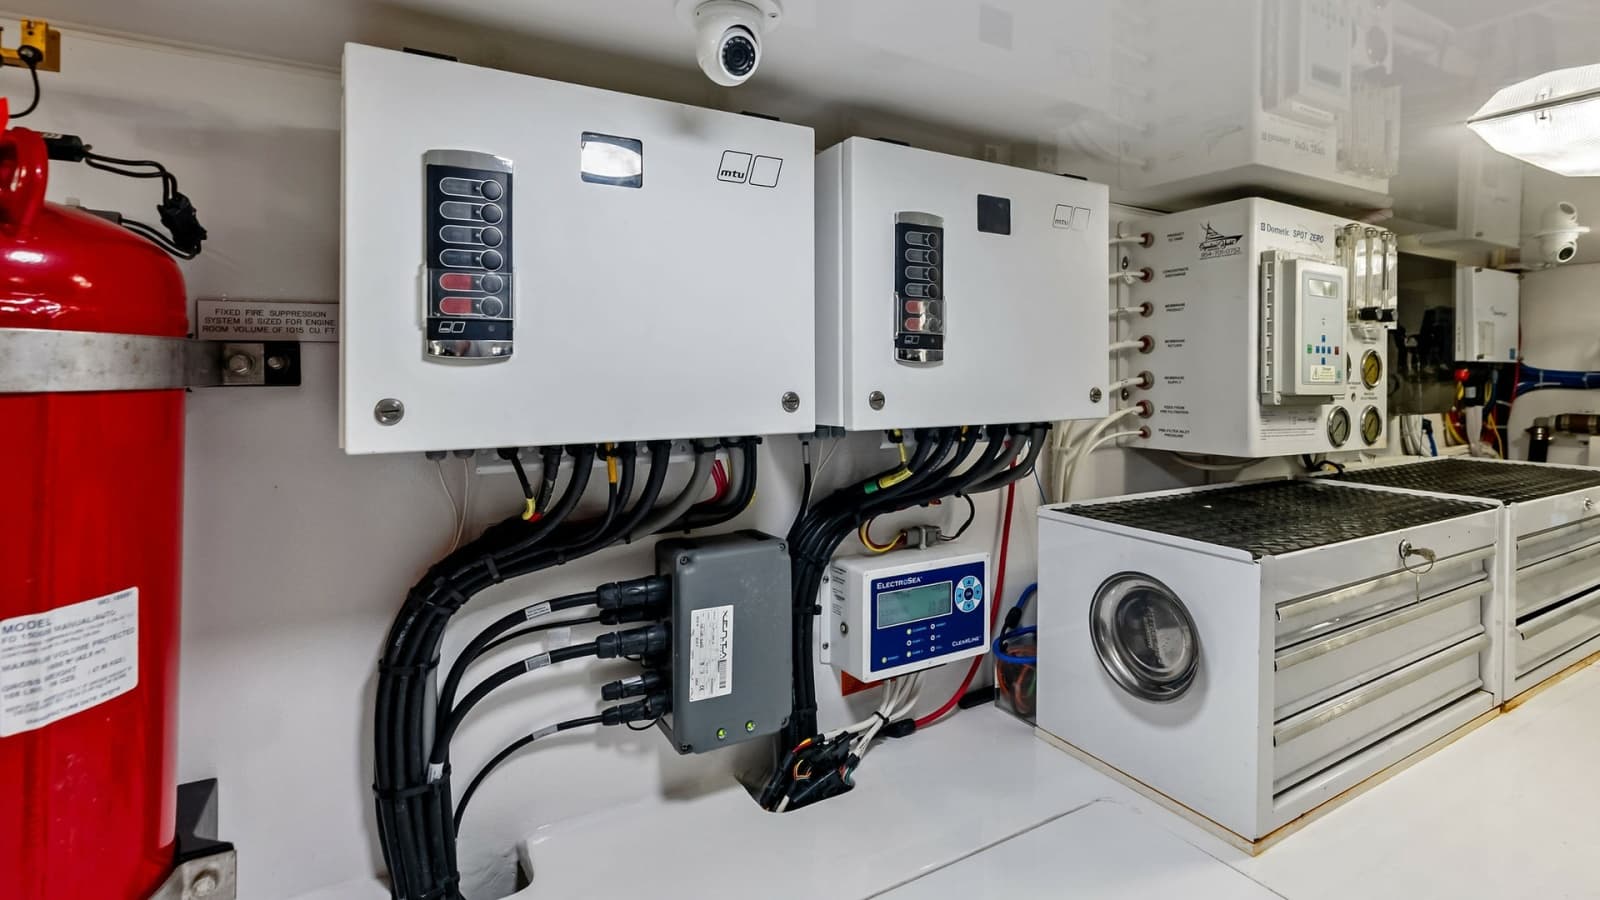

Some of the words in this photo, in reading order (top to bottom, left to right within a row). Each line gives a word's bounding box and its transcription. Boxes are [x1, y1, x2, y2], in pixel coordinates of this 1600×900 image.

[720, 169, 745, 179] mtu
[1054, 218, 1069, 226] mtu
[1266, 223, 1289, 236] Dometic
[1292, 230, 1308, 239] SPOT
[1309, 232, 1324, 243] ZERO
[215, 308, 241, 316] FIXED
[245, 309, 264, 317] FIRE
[269, 310, 327, 318] SUPPRESSION
[204, 317, 240, 325] SYSTEM
[285, 318, 302, 326] FOR
[2, 618, 52, 635] MODEL
